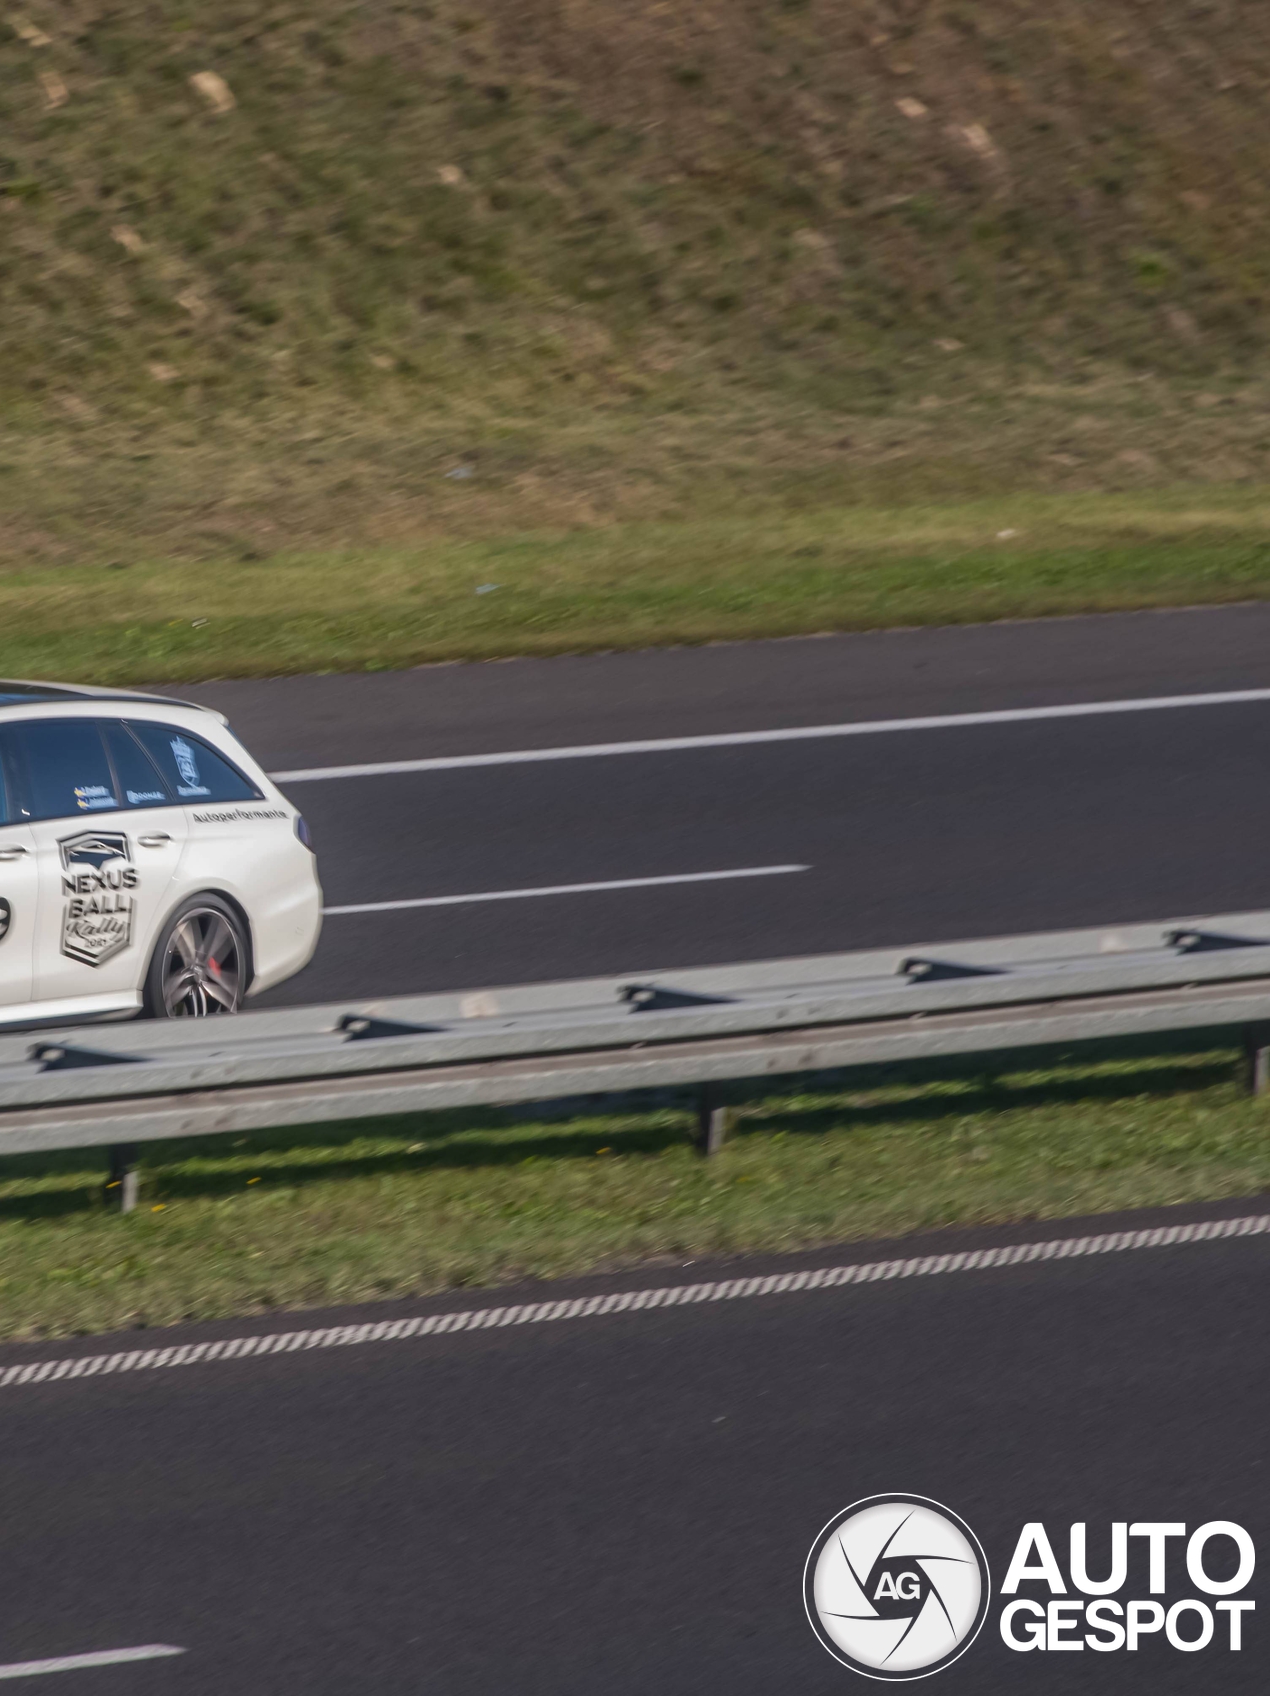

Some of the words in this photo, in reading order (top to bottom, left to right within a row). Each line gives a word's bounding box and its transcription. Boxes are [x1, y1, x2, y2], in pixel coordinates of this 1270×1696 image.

[193, 808, 289, 824] Autoperformante
[61, 867, 139, 897] NEXUS
[69, 894, 128, 919] BALL
[65, 917, 126, 943] Rally
